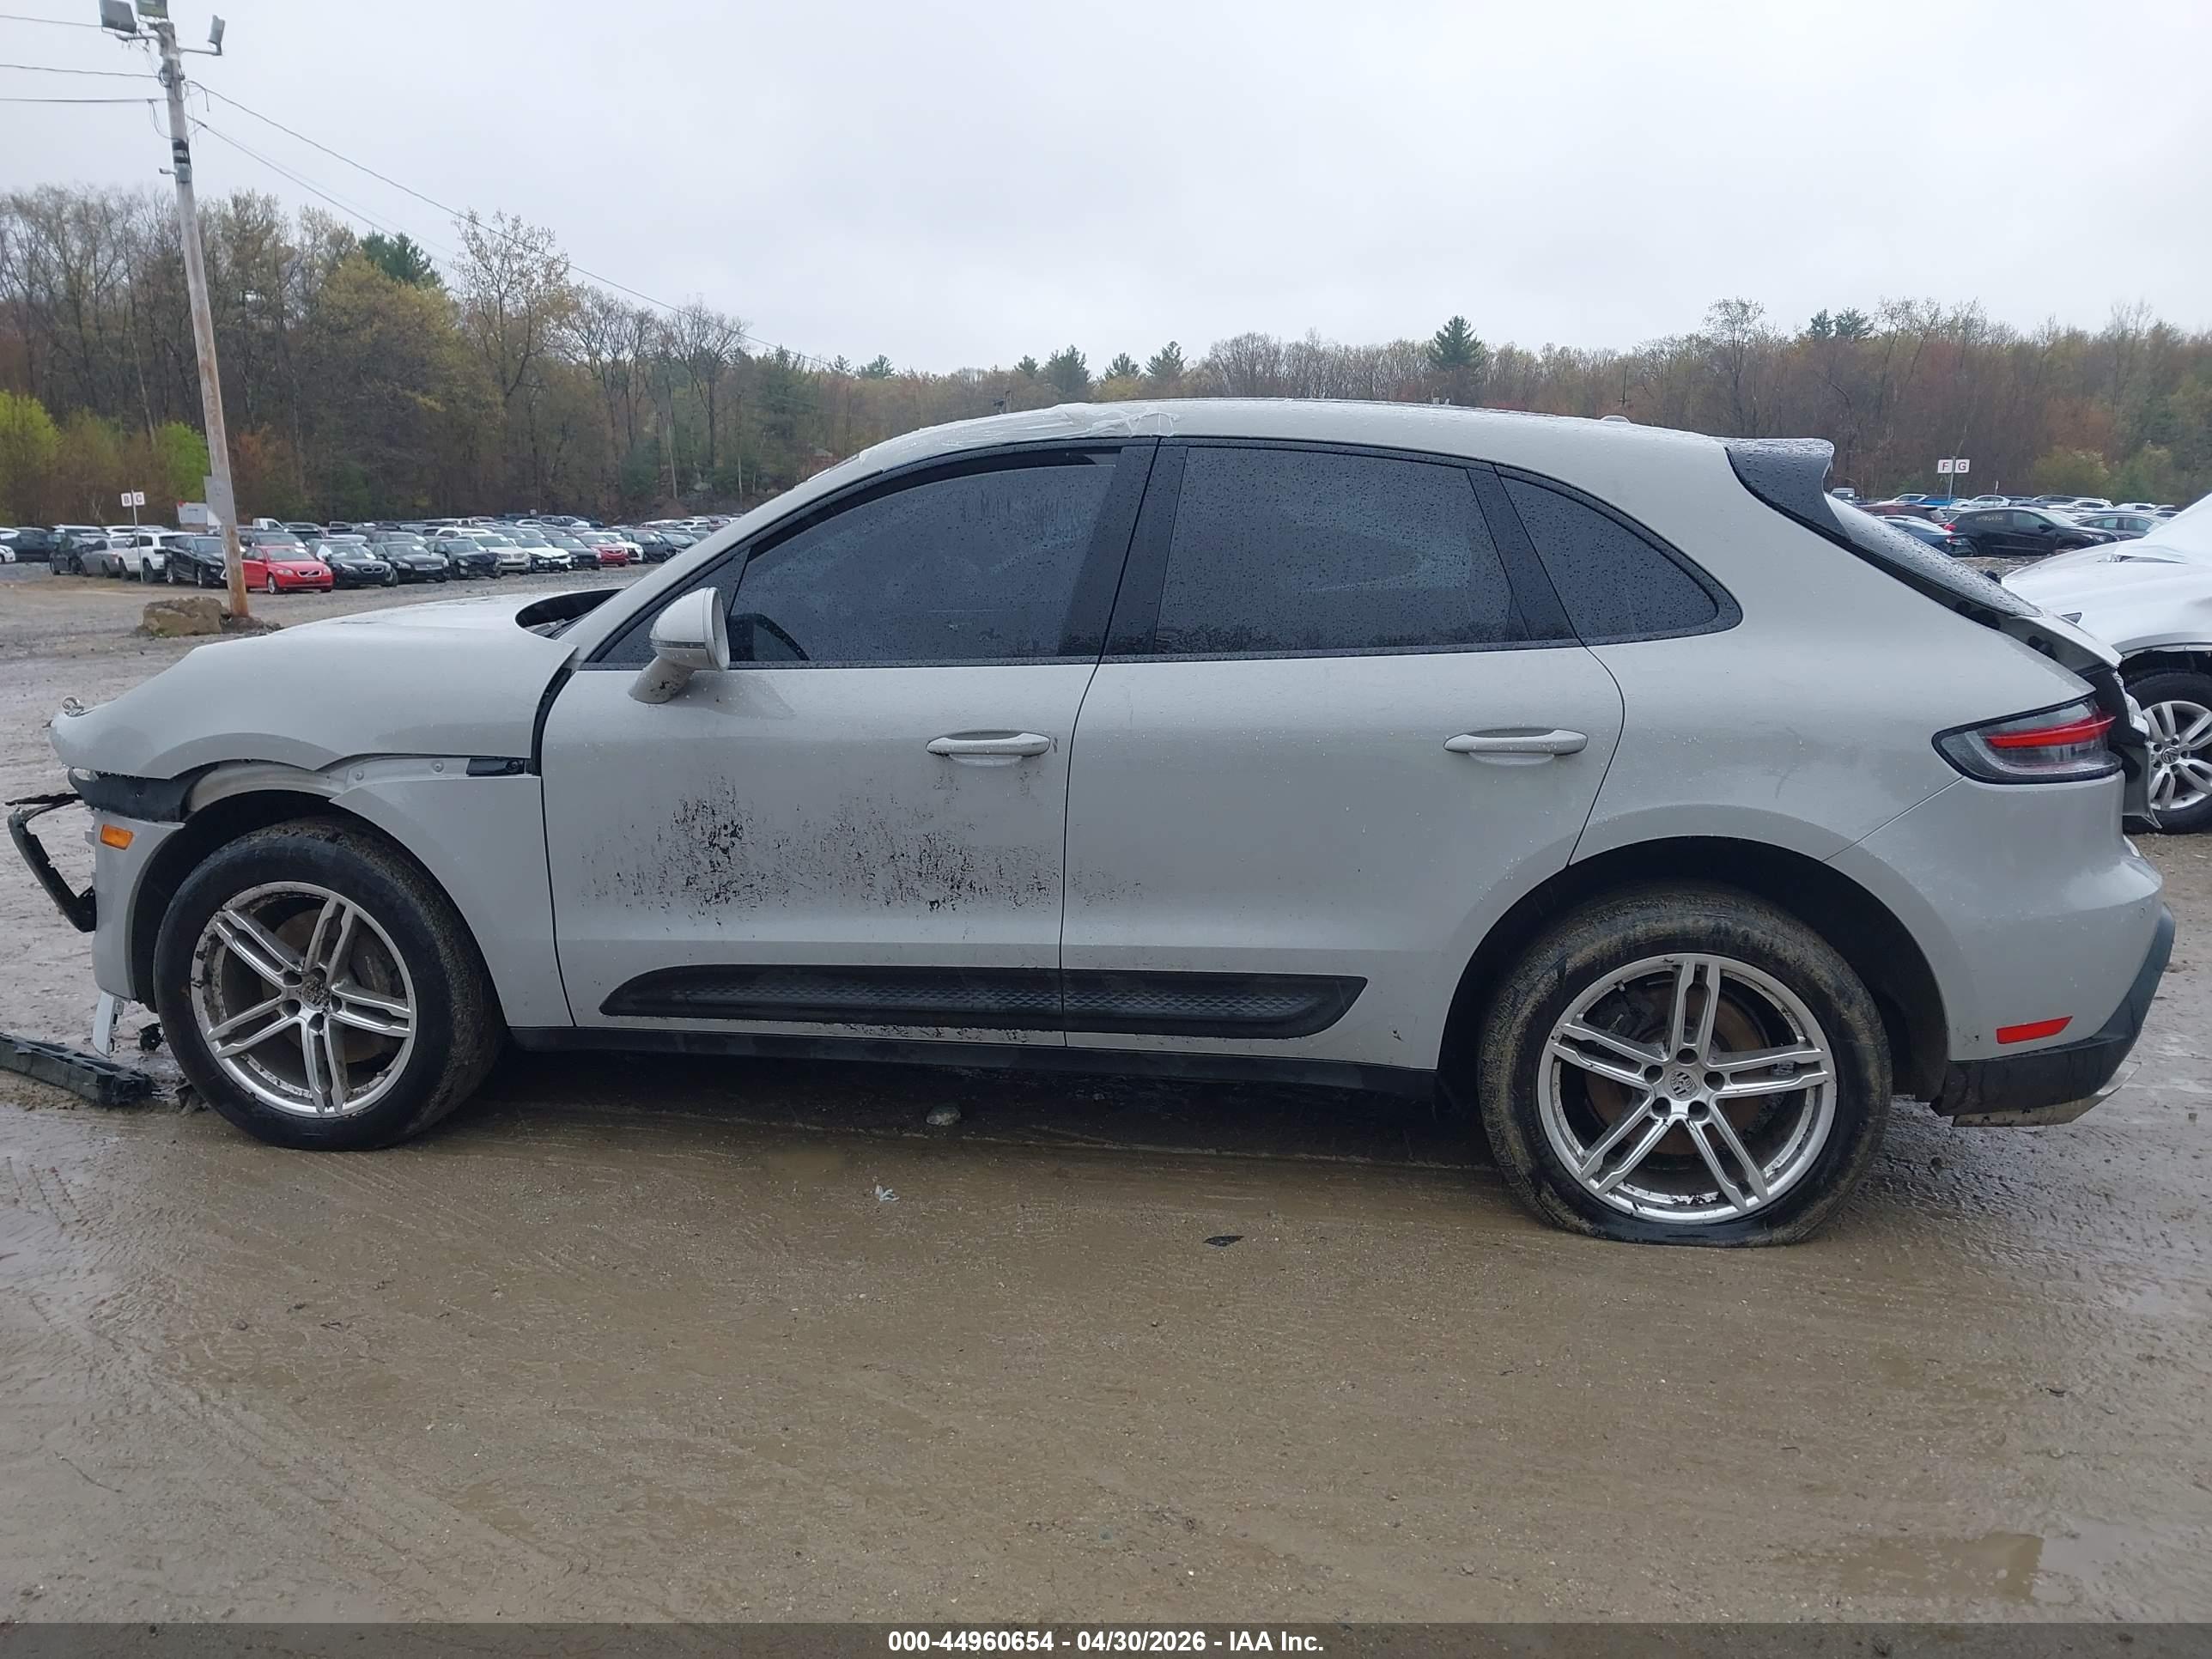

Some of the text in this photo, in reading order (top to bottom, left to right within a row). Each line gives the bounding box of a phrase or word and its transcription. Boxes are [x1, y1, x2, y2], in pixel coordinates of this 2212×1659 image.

[1942, 461, 1966, 471] F G
[124, 495, 143, 504] B C
